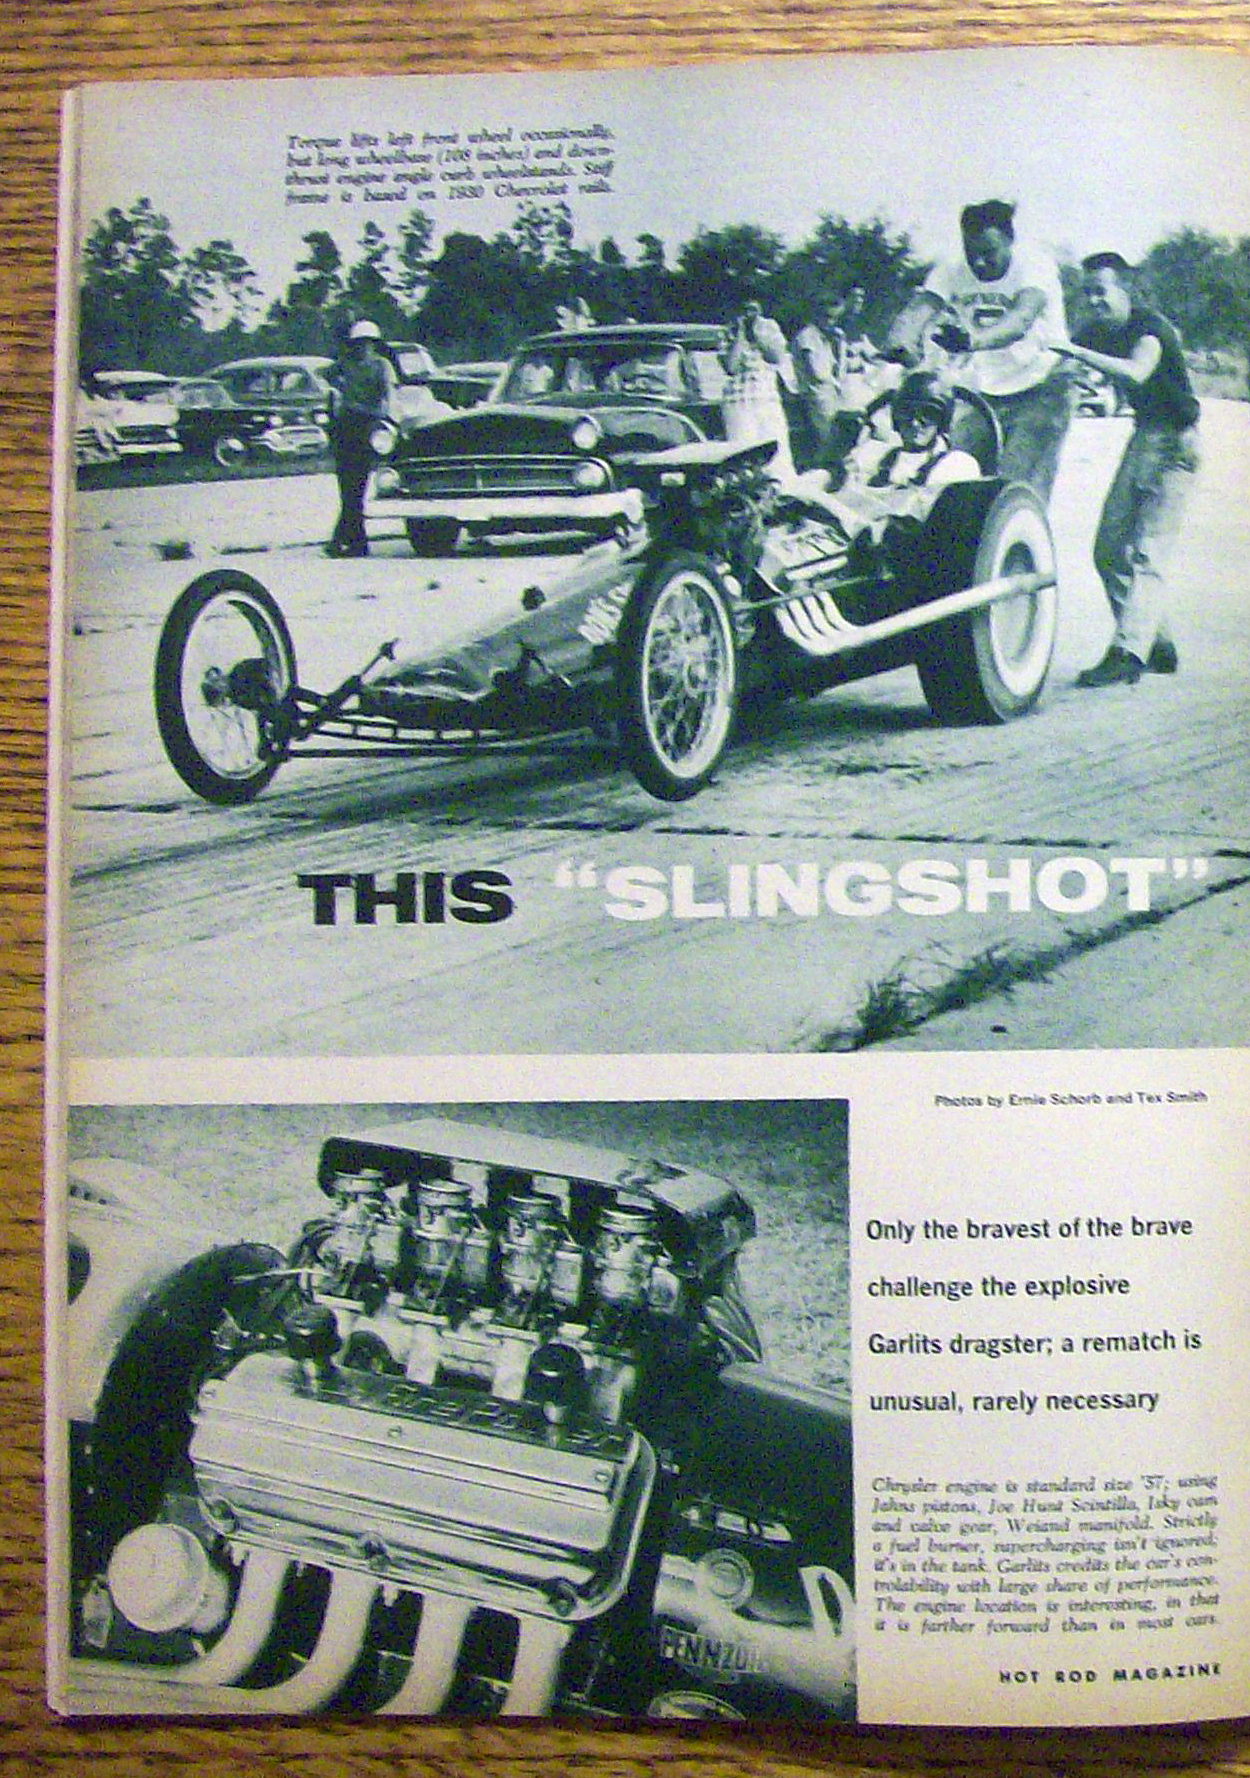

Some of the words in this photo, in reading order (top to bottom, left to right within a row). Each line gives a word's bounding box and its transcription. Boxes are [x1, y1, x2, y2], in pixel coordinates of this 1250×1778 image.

[297, 869, 515, 925] THIS
[552, 857, 1209, 922] “SLINGSHOT”
[934, 1095, 984, 1106] Photos
[987, 1096, 1005, 1108] by
[1008, 1094, 1047, 1106] Ernie
[1106, 1093, 1134, 1104] and
[1138, 1092, 1163, 1103] Tex
[1167, 1091, 1208, 1103] Smith
[866, 1220, 915, 1243] Only
[923, 1220, 959, 1239] the
[966, 1220, 1051, 1238] bravest
[1059, 1218, 1081, 1237] of
[1087, 1218, 1123, 1237] the
[1131, 1217, 1193, 1236] brave
[868, 1277, 973, 1301] challenge
[982, 1277, 1017, 1296] the
[1025, 1275, 1130, 1296] explosive
[869, 1334, 943, 1354] Garlits
[949, 1335, 1055, 1357] dragster;
[1062, 1338, 1075, 1352] a
[1082, 1331, 1177, 1352] rematch
[1184, 1330, 1202, 1349] is
[870, 1393, 965, 1412] unusual,
[973, 1393, 1038, 1414] rarely
[1046, 1394, 1159, 1411] necessary
[999, 1671, 1039, 1683] HOT
[1055, 1671, 1097, 1682] ROD
[1113, 1665, 1221, 1680] MAGAZINE
